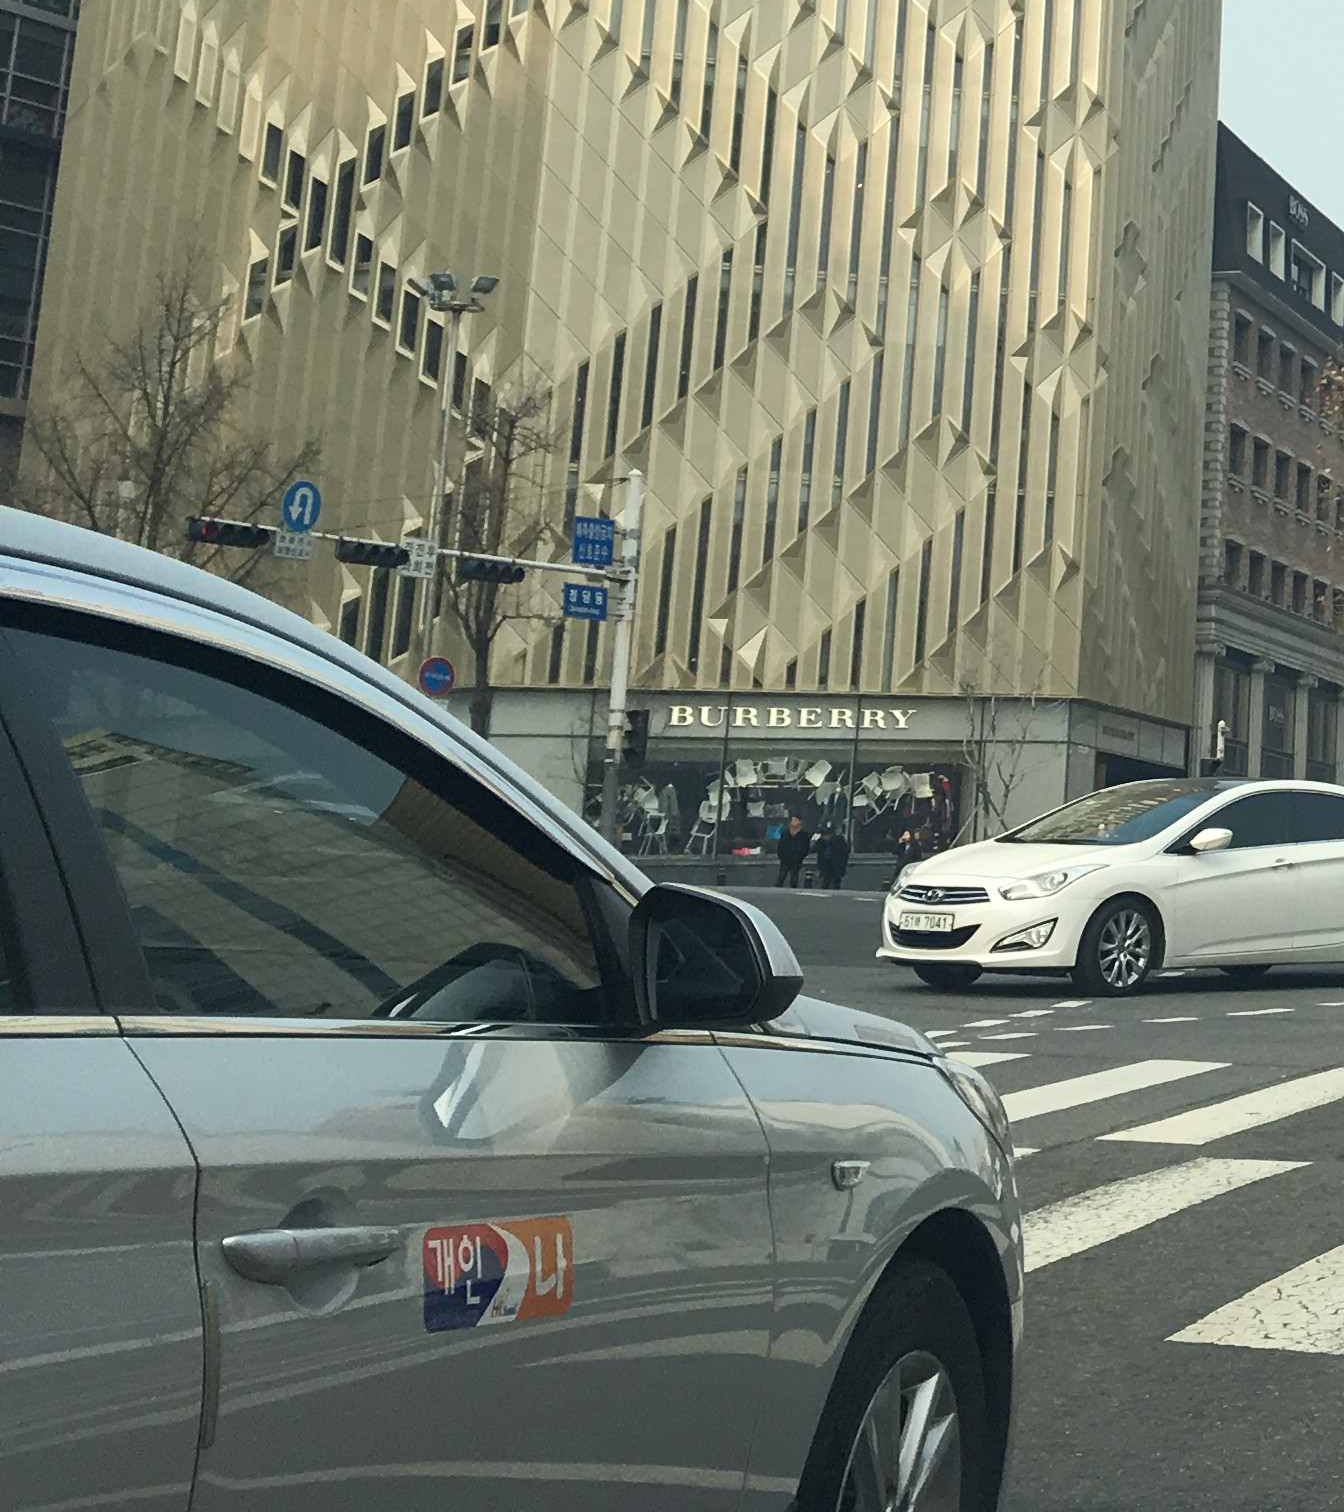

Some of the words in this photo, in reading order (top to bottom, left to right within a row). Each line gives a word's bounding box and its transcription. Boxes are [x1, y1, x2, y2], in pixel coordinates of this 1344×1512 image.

[668, 705, 918, 730] BURBERRY
[924, 916, 947, 929] 7041
[428, 1234, 482, 1306] 개인
